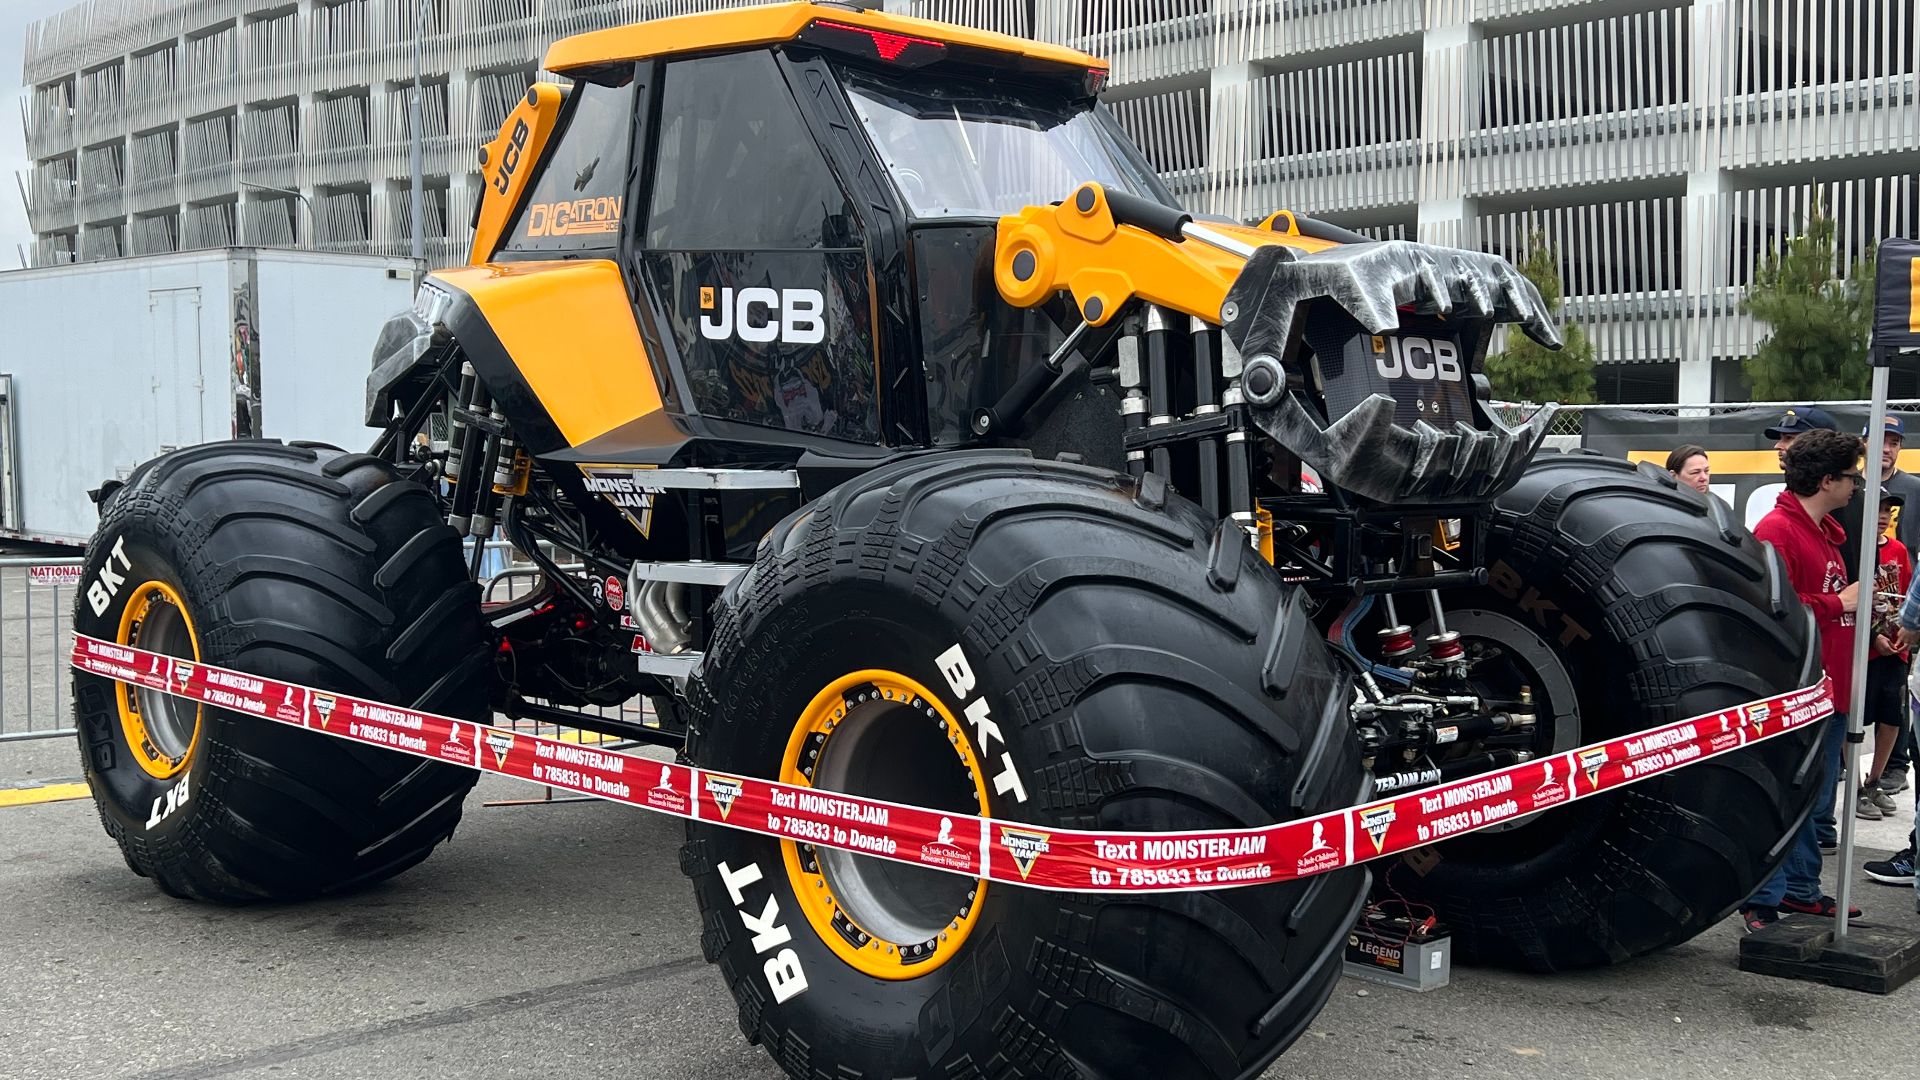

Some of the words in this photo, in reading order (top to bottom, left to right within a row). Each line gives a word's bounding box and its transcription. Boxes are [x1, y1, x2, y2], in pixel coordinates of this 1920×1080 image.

[493, 117, 529, 196] JCB
[700, 287, 825, 344] JCB
[1372, 336, 1462, 382] JCB
[582, 477, 667, 494] MONS
[615, 493, 651, 509] JAM
[30, 566, 82, 577] NATIONAL
[86, 535, 132, 618] BKT
[1487, 558, 1592, 648] BKT
[206, 670, 219, 684] Text
[220, 672, 263, 694] MONSTERJAM
[203, 688, 211, 699] to
[211, 690, 235, 705] 785833
[235, 694, 242, 707] to
[243, 697, 266, 713] Donate
[352, 702, 368, 718] Text
[368, 706, 422, 730] MONSTERJAM
[350, 722, 358, 735] to
[359, 724, 388, 742] 785833
[389, 730, 397, 744] to
[399, 732, 427, 751] Donate
[934, 643, 1029, 804] BKT
[1624, 739, 1644, 756] Text
[1642, 724, 1698, 752] MONSTERJAM
[535, 741, 555, 759] Text
[555, 746, 623, 773] MONSTERJAM
[1622, 764, 1633, 779] to
[1632, 754, 1664, 775] 785833
[1662, 752, 1673, 765] to
[1671, 744, 1701, 763] Donate
[533, 762, 542, 778] to
[545, 765, 580, 786] 785833
[582, 773, 592, 789] to
[594, 775, 630, 797] Donate
[705, 782, 742, 797] MONSTER
[1419, 794, 1442, 814] Text
[1443, 775, 1512, 808] MONSTERJAM
[146, 771, 190, 830] BKT
[770, 787, 796, 809] Text
[798, 793, 889, 826] MONSTERJAM
[767, 812, 780, 831] to
[783, 816, 830, 841] 785833
[833, 825, 847, 844] to
[849, 828, 897, 855] Donate
[1361, 811, 1396, 829] MONSTER
[1417, 824, 1430, 841] to
[1430, 811, 1470, 837] 785833
[1470, 809, 1482, 825] to
[1483, 799, 1518, 821] Donate
[1001, 836, 1049, 853] MONSTER
[1012, 848, 1035, 859] JAM
[1094, 839, 1137, 860] Text
[1143, 835, 1266, 860] MONSTERJAM
[1090, 867, 1111, 885] to
[717, 860, 809, 1005] BKT
[1360, 942, 1401, 960] LEGEND
